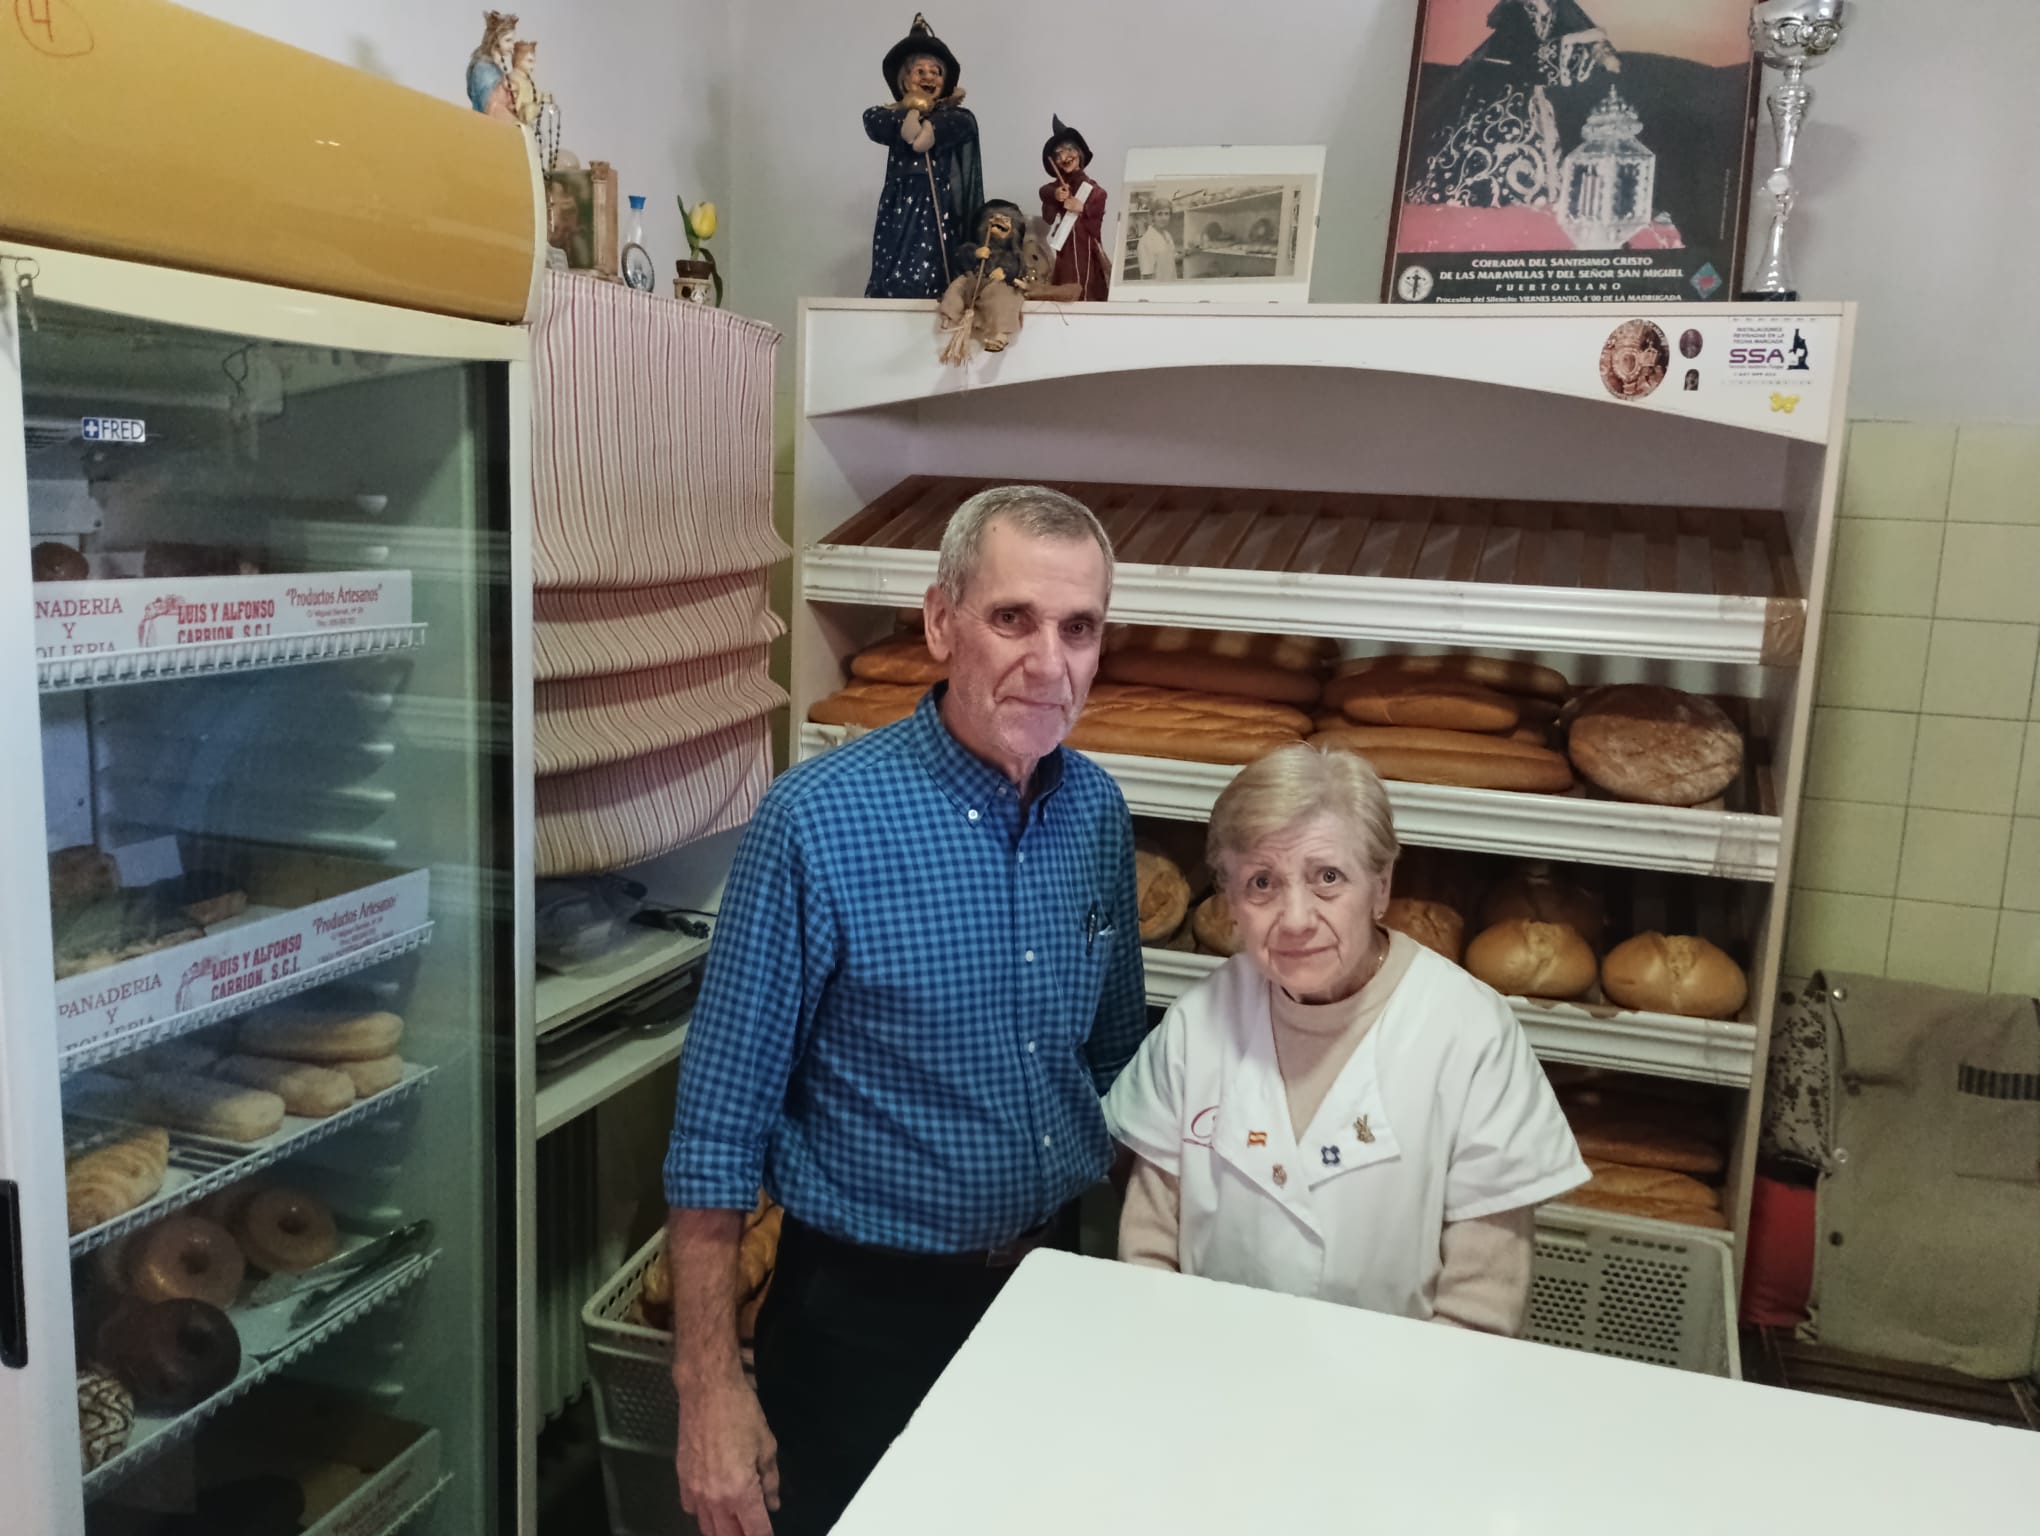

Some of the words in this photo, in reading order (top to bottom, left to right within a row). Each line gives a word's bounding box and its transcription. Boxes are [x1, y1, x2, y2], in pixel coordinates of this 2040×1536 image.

[1528, 258, 1548, 267] DEL
[1612, 256, 1653, 266] CRISTO
[1440, 271, 1454, 280] DE
[1455, 271, 1476, 280] LAS
[1477, 270, 1545, 280] MARAVILLAS
[1546, 270, 1555, 279] Y
[1556, 270, 1576, 279] DEL
[1578, 268, 1614, 279] SEÑOR
[1617, 269, 1640, 278] SAN
[1643, 268, 1684, 278] MIGUEL
[1495, 282, 1622, 292] PUERTOLLANO
[1518, 295, 1550, 303] VIERNES
[1603, 294, 1614, 302] DE
[1614, 294, 1626, 302] LA
[1627, 294, 1682, 302] MADRUGADA
[1728, 348, 1785, 364] SSA
[102, 419, 144, 440] FRED
[178, 603, 207, 625] LUIS
[211, 602, 219, 622] Y
[222, 599, 275, 621] ALFONSO
[62, 622, 77, 639] Y
[212, 955, 239, 981] LUIS
[243, 951, 250, 969] Y
[253, 932, 302, 967] ALFONSO
[59, 973, 163, 1018] PANADERIA
[107, 1006, 118, 1025] Y
